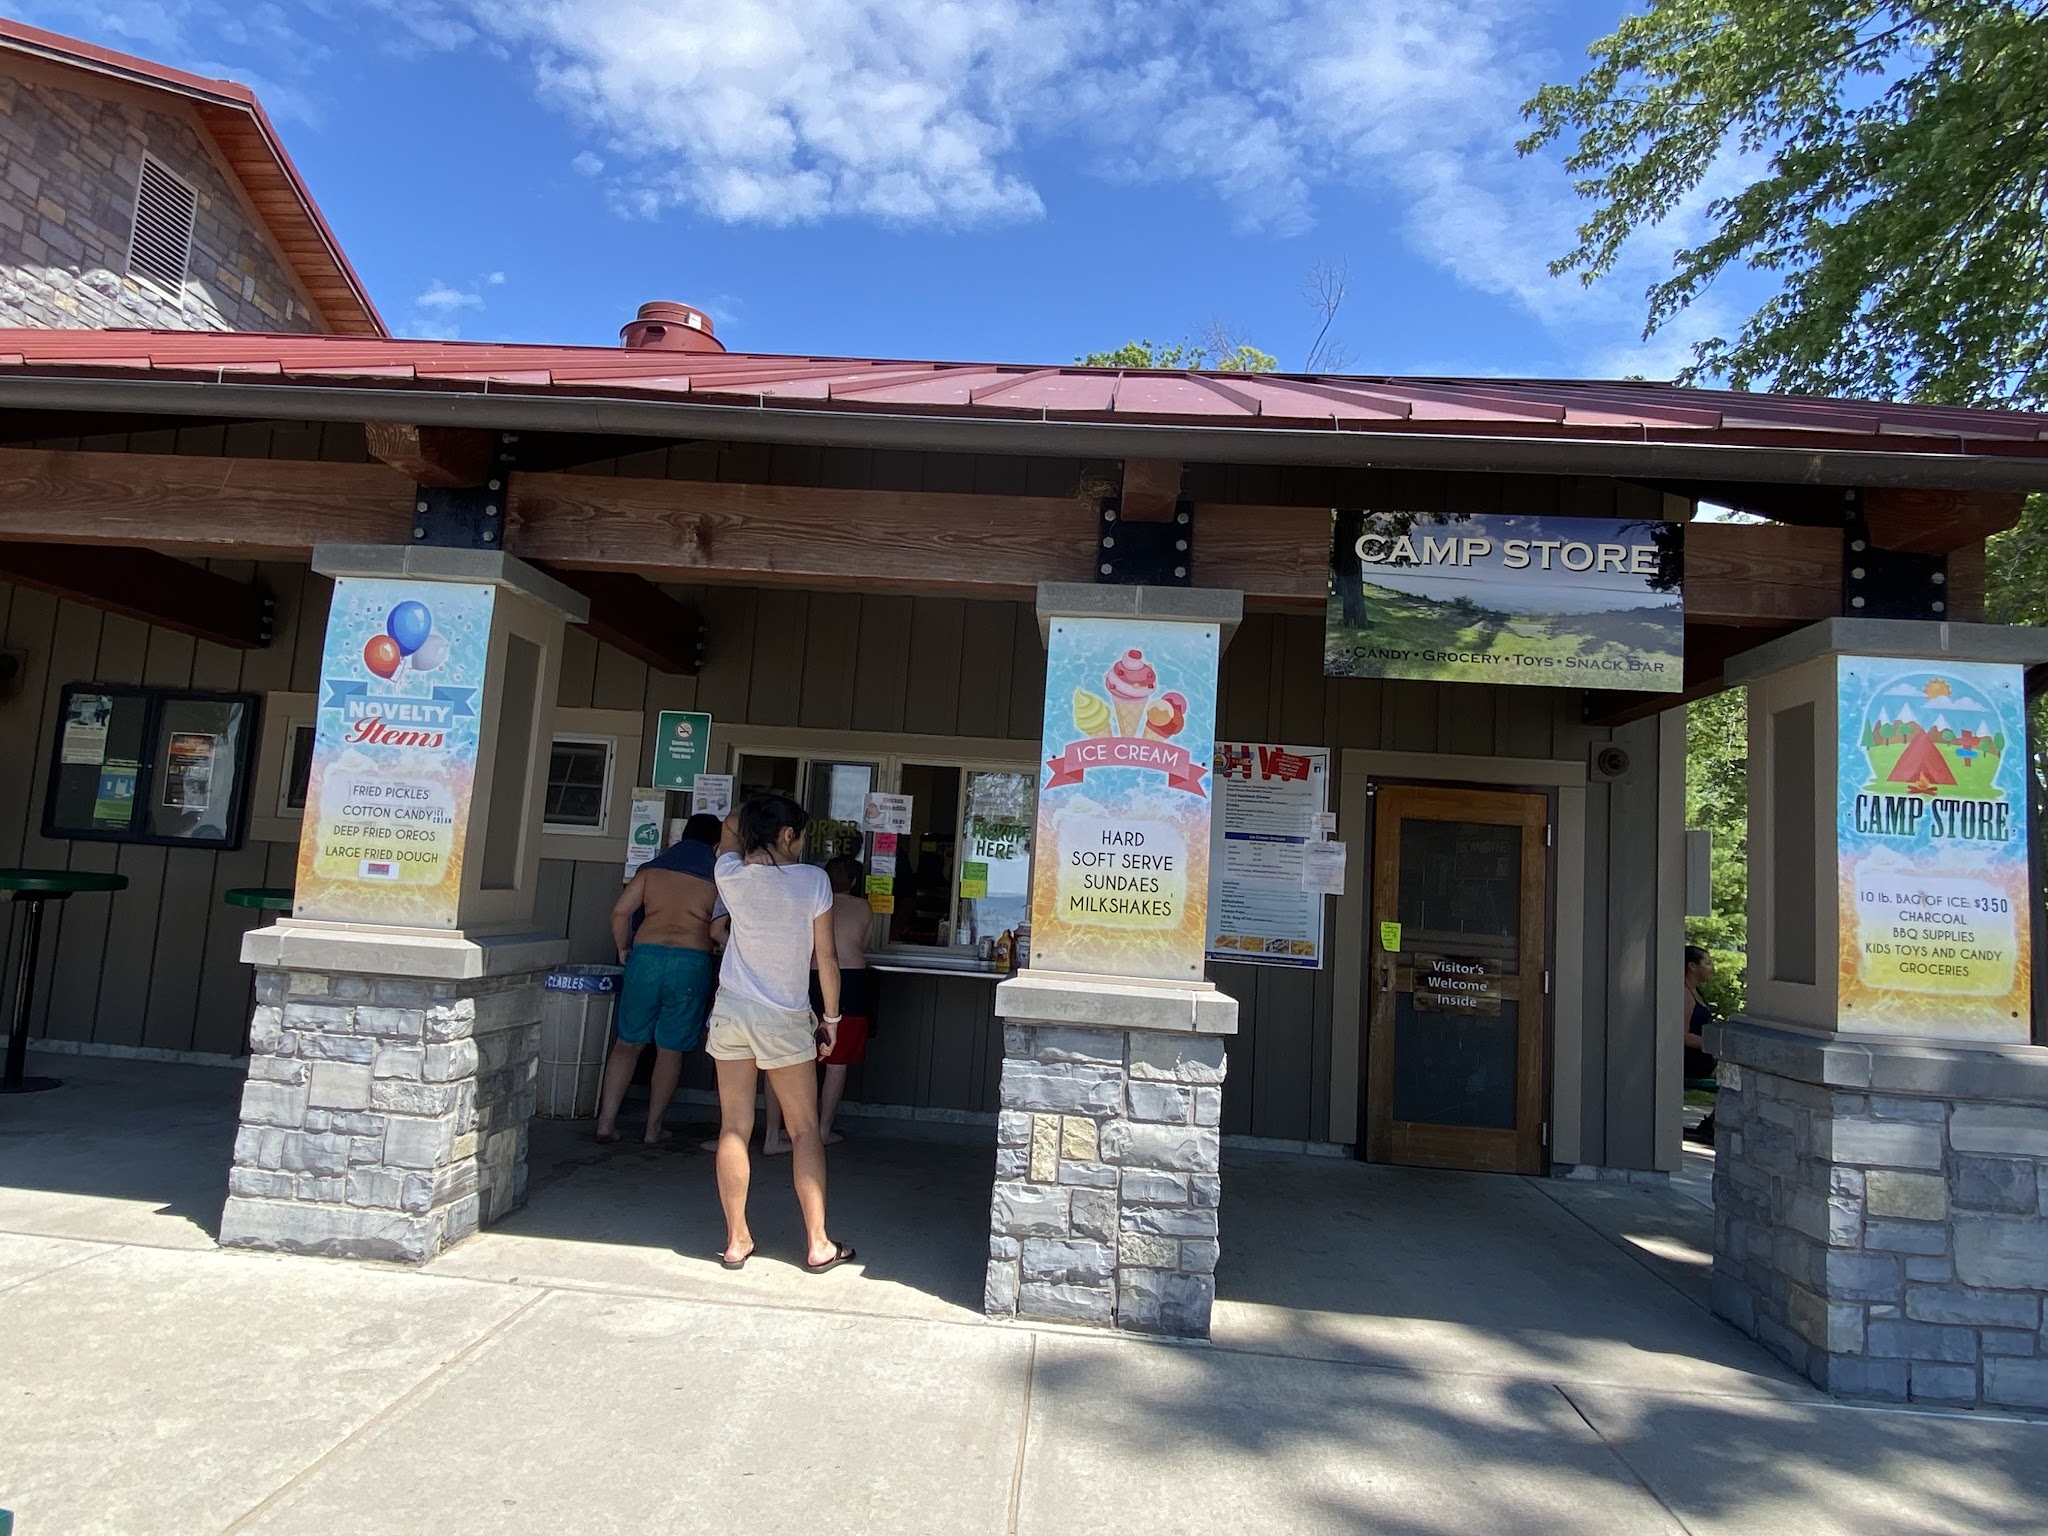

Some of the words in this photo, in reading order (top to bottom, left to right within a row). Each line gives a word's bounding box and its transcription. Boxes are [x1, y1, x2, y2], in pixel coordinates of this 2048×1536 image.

[1354, 533, 1493, 567] CAMP
[1503, 539, 1660, 575] STORE
[1354, 646, 1411, 662] CANDY
[1423, 650, 1501, 666] GROCERY
[1513, 653, 1554, 668] TOYS
[1565, 656, 1624, 672] SNACK
[1629, 659, 1665, 674] BAR
[350, 701, 450, 723] NOVELTY
[344, 716, 445, 748] Items
[1077, 744, 1107, 763] ICE
[1114, 744, 1179, 767] CREAM
[353, 785, 382, 798] FRIED
[385, 787, 430, 800] PICKLES
[342, 805, 391, 818] COTTON
[394, 808, 433, 821] CANDY
[1855, 794, 1923, 836] CAMP
[1931, 799, 2010, 842] STORE
[333, 825, 360, 837] DEEP
[362, 827, 392, 839] FRIED
[395, 829, 436, 842] OREOS
[1102, 830, 1145, 847] HARD
[325, 845, 361, 858] LARGE
[363, 847, 393, 860] FRIED
[396, 849, 439, 863] DOUGH
[810, 837, 852, 856] HERE
[976, 840, 1015, 860] HERE
[1071, 851, 1116, 868] SOFT
[1121, 853, 1173, 871] SERVE
[1083, 874, 1159, 893] SUNDAES
[1070, 895, 1172, 917] MILKSHAKES
[1860, 891, 1875, 904] 10
[1896, 893, 1921, 906] BAG
[1924, 895, 1943, 907] OF
[1898, 910, 1968, 926] CHARCOAL
[1893, 927, 1918, 941] BBQ
[1922, 929, 1975, 943] SUPPLIES
[1865, 942, 1891, 955] KIDS
[1894, 944, 1928, 957] TOYS
[1931, 947, 1956, 959] AND
[1960, 949, 2003, 962] CANDY
[1432, 960, 1485, 976] Visitor's
[1899, 962, 1969, 977] GROCERIES
[1428, 976, 1488, 992] Welcome
[1437, 994, 1478, 1009] Inside
